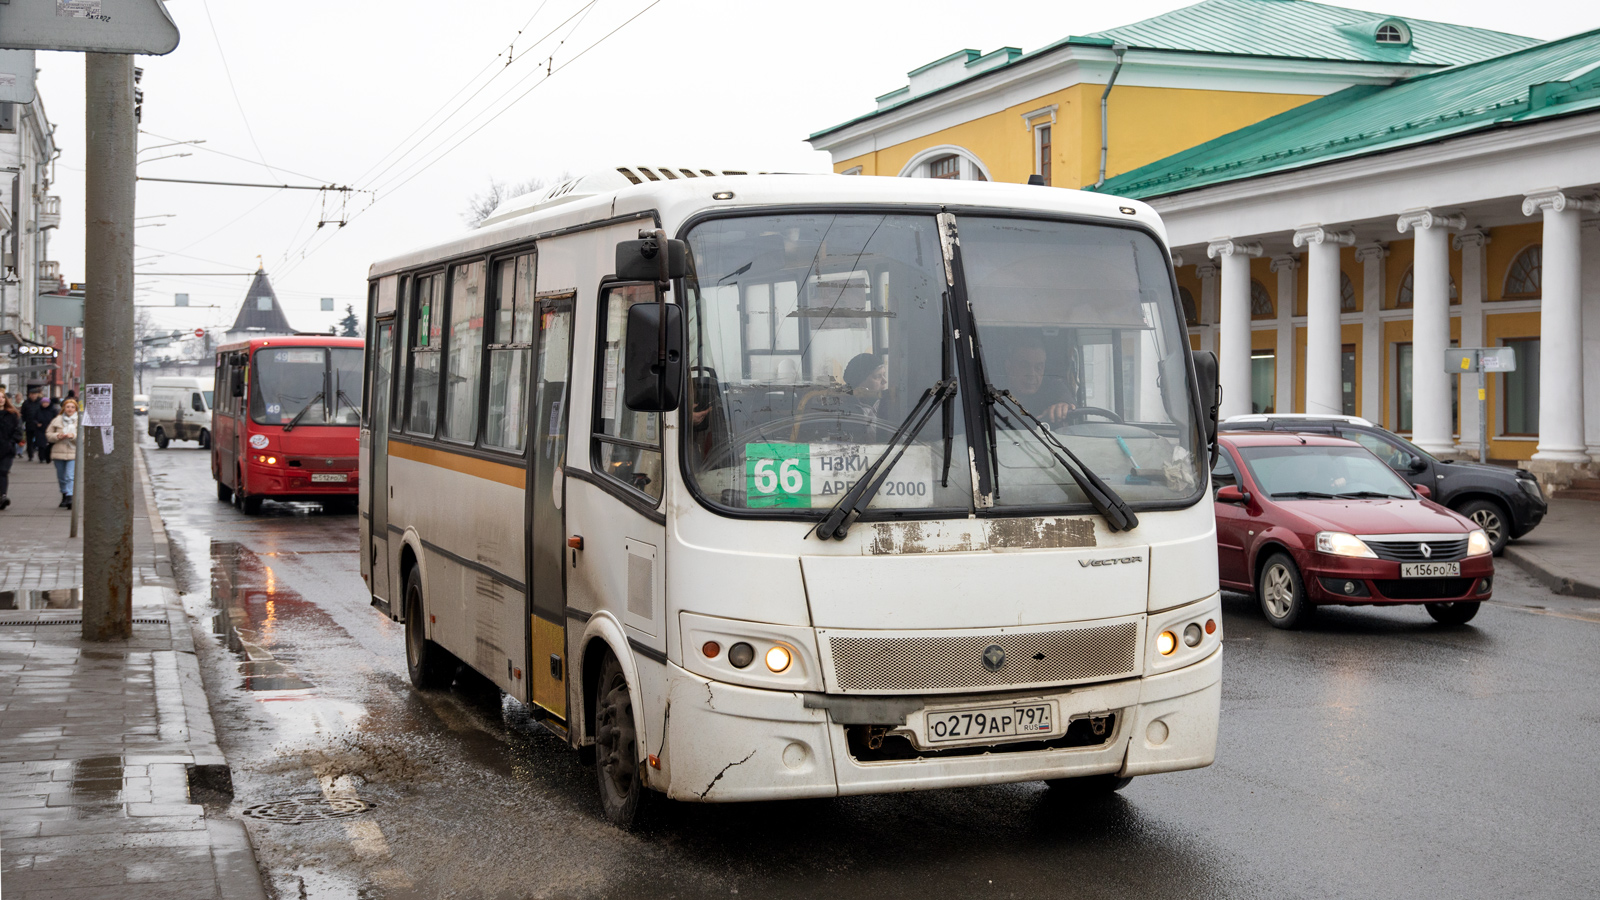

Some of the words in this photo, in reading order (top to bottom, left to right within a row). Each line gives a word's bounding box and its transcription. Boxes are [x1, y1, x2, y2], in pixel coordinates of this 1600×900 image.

[18, 345, 53, 355] ФОТО
[275, 352, 288, 361] 49
[267, 404, 281, 414] 49
[820, 455, 870, 471] НЗКИ
[754, 458, 803, 494] 66
[821, 480, 881, 495] АРЕ
[885, 481, 926, 496] 2000
[1077, 555, 1143, 568] VECTOR
[1405, 564, 1446, 576] К156РО
[1447, 563, 1457, 572] 76
[934, 712, 1012, 737] О279АР
[1015, 707, 1045, 725] 797
[1023, 723, 1039, 731] RUS
